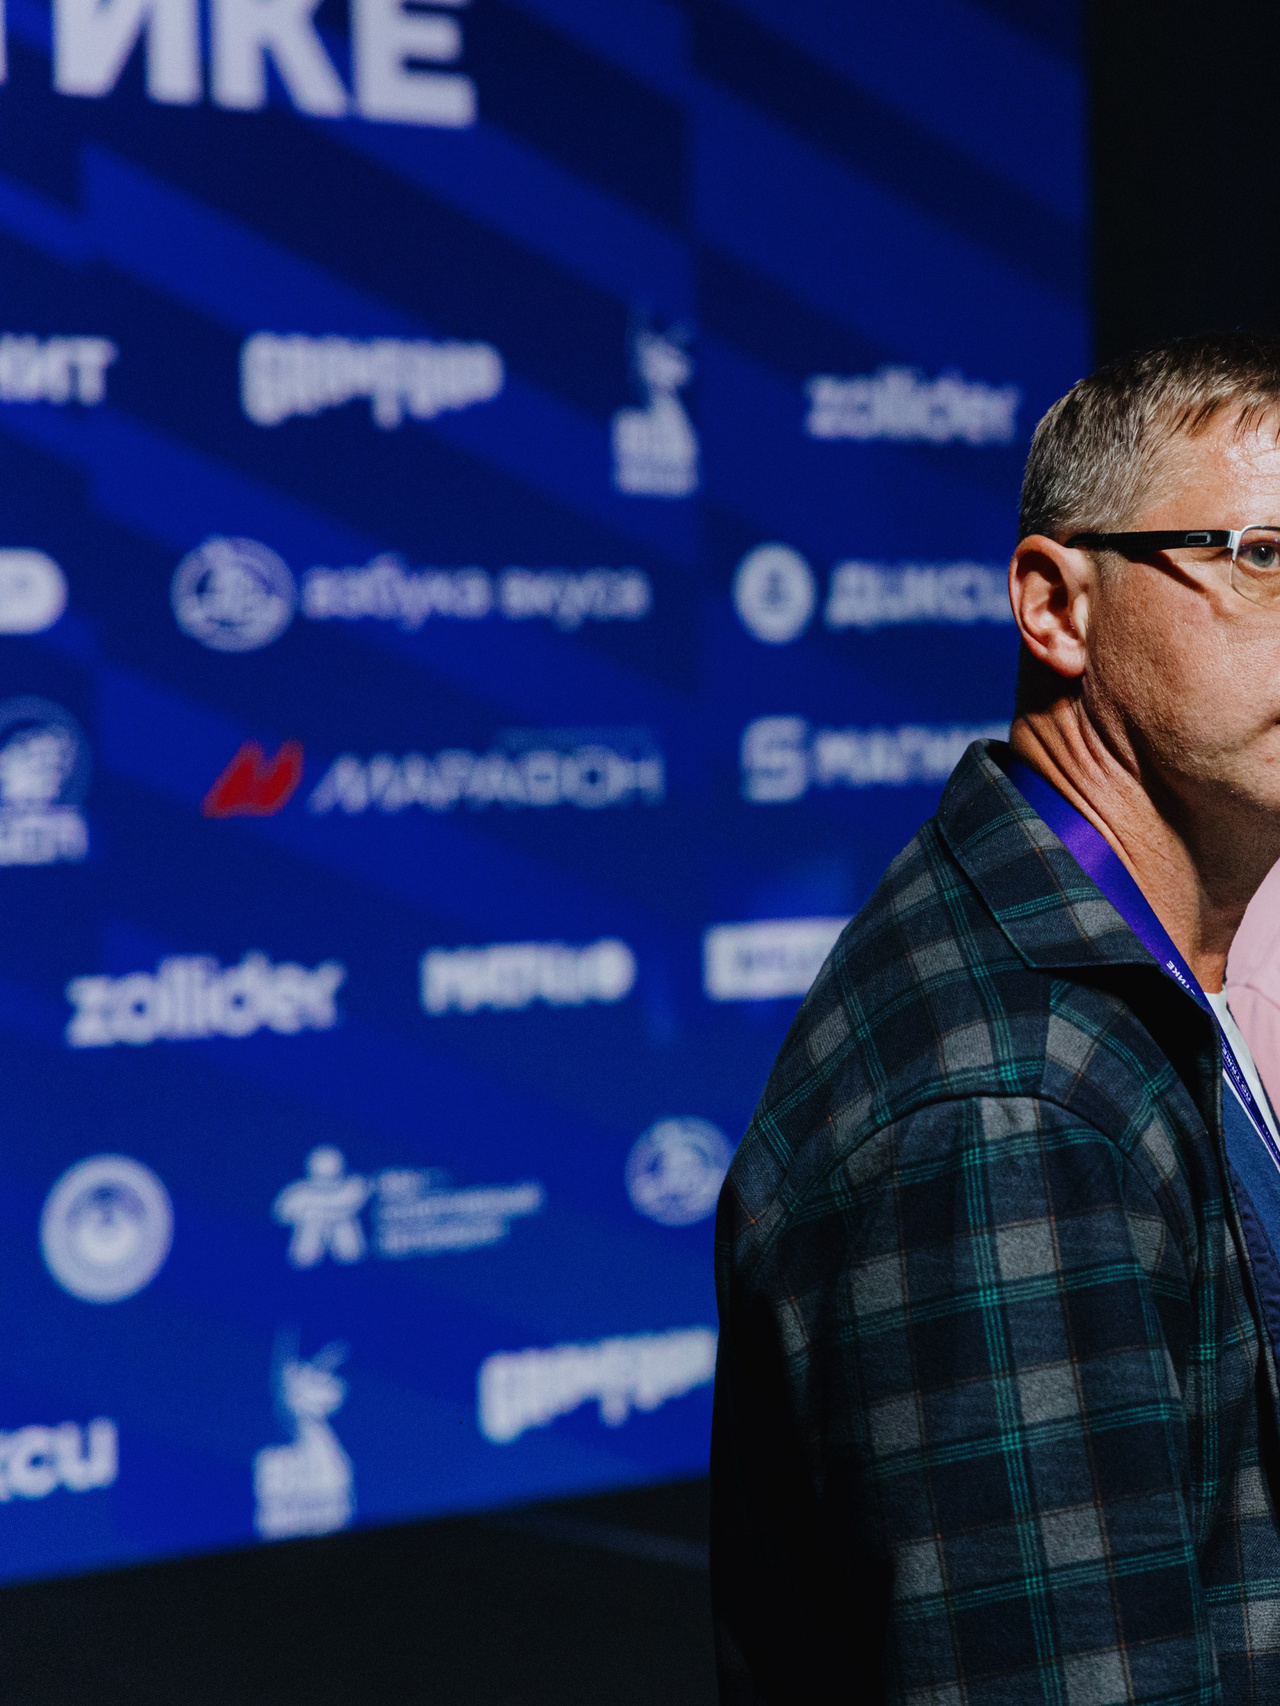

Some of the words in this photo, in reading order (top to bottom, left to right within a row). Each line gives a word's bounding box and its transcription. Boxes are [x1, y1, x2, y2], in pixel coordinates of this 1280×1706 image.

[0, 0, 476, 128] ИКЕ
[68, 953, 343, 1048] zollider
[0, 1420, 117, 1502] СИ
